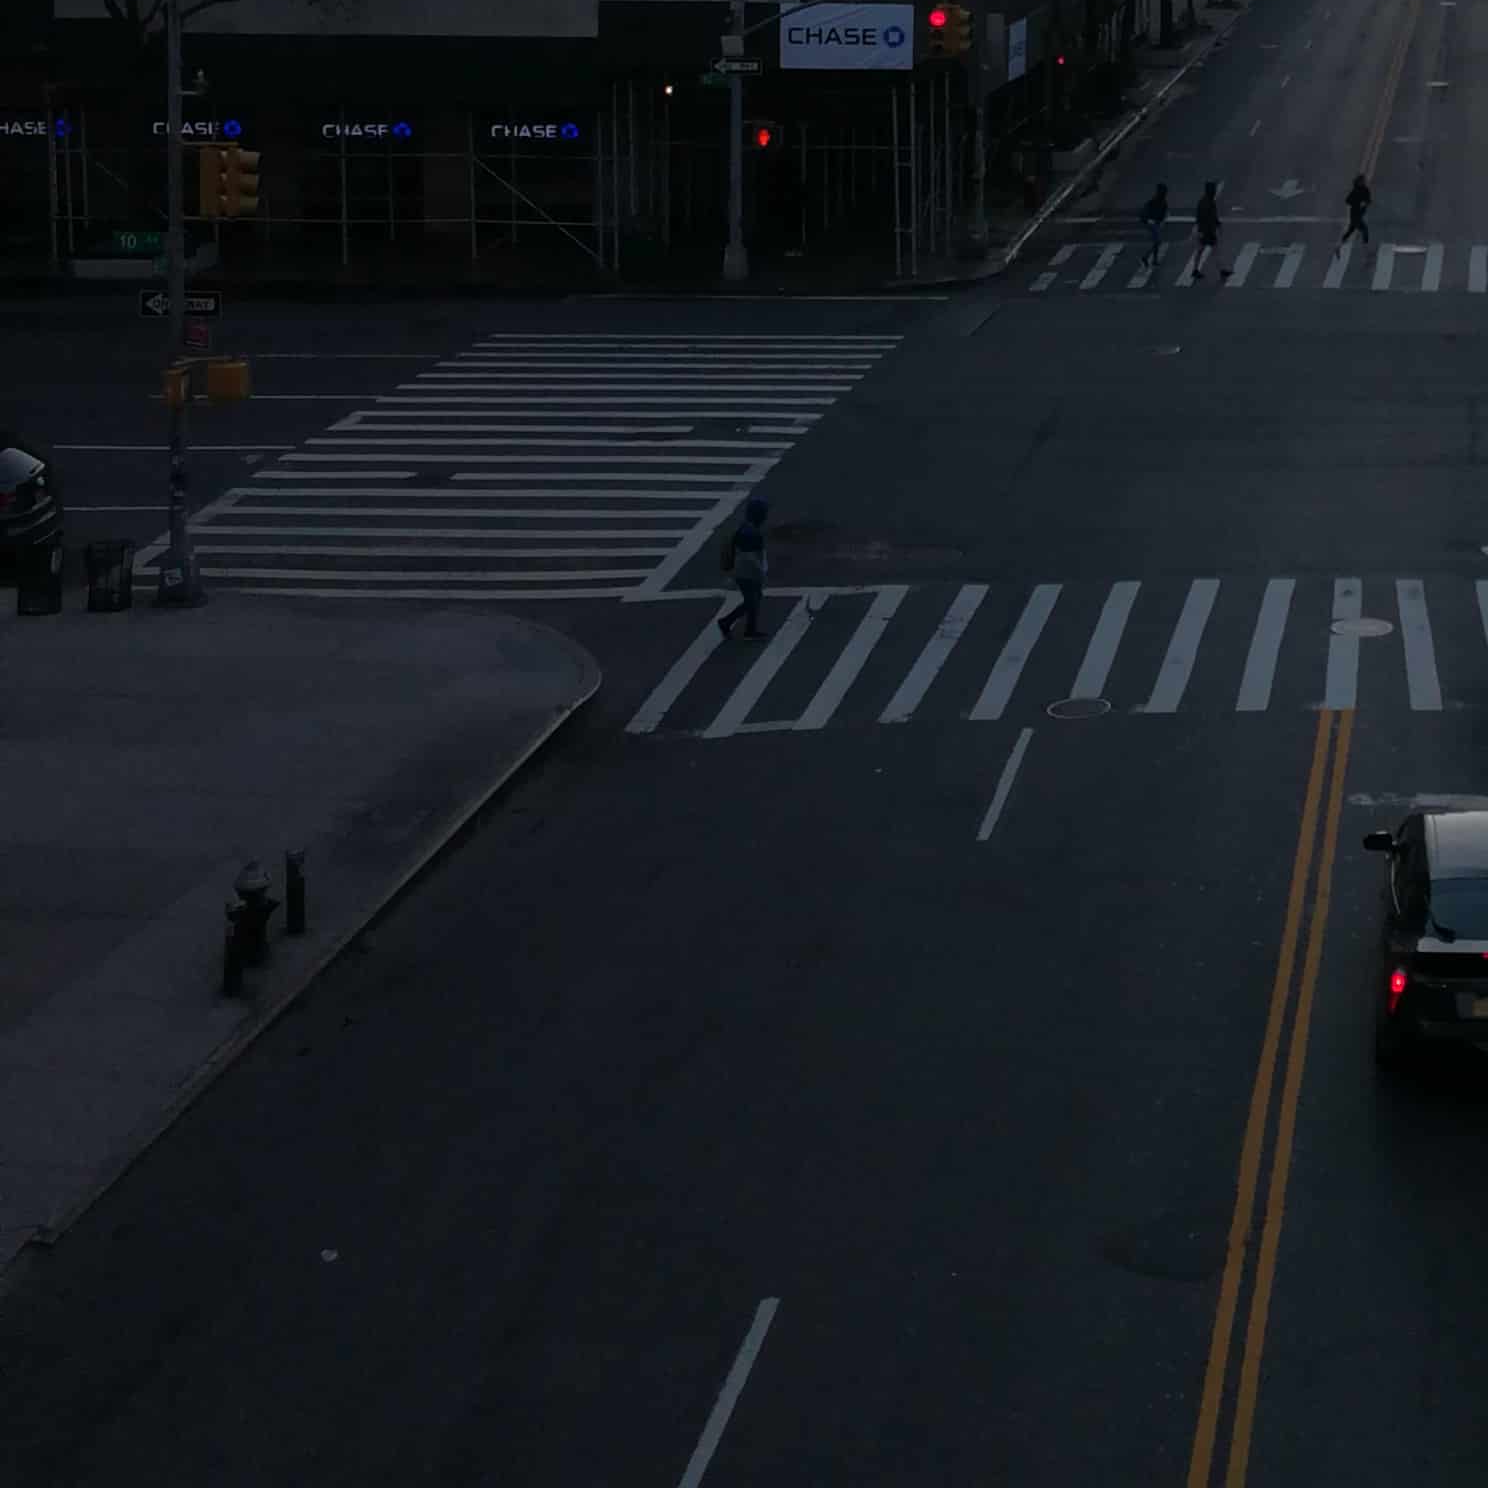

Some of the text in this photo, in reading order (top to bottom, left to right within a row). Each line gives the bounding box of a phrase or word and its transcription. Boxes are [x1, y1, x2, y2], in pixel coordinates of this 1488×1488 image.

[788, 27, 877, 45] CHASE
[0, 120, 48, 136] HASE
[322, 119, 389, 139] CHASE
[490, 119, 559, 138] CHASE
[119, 233, 137, 249] 10
